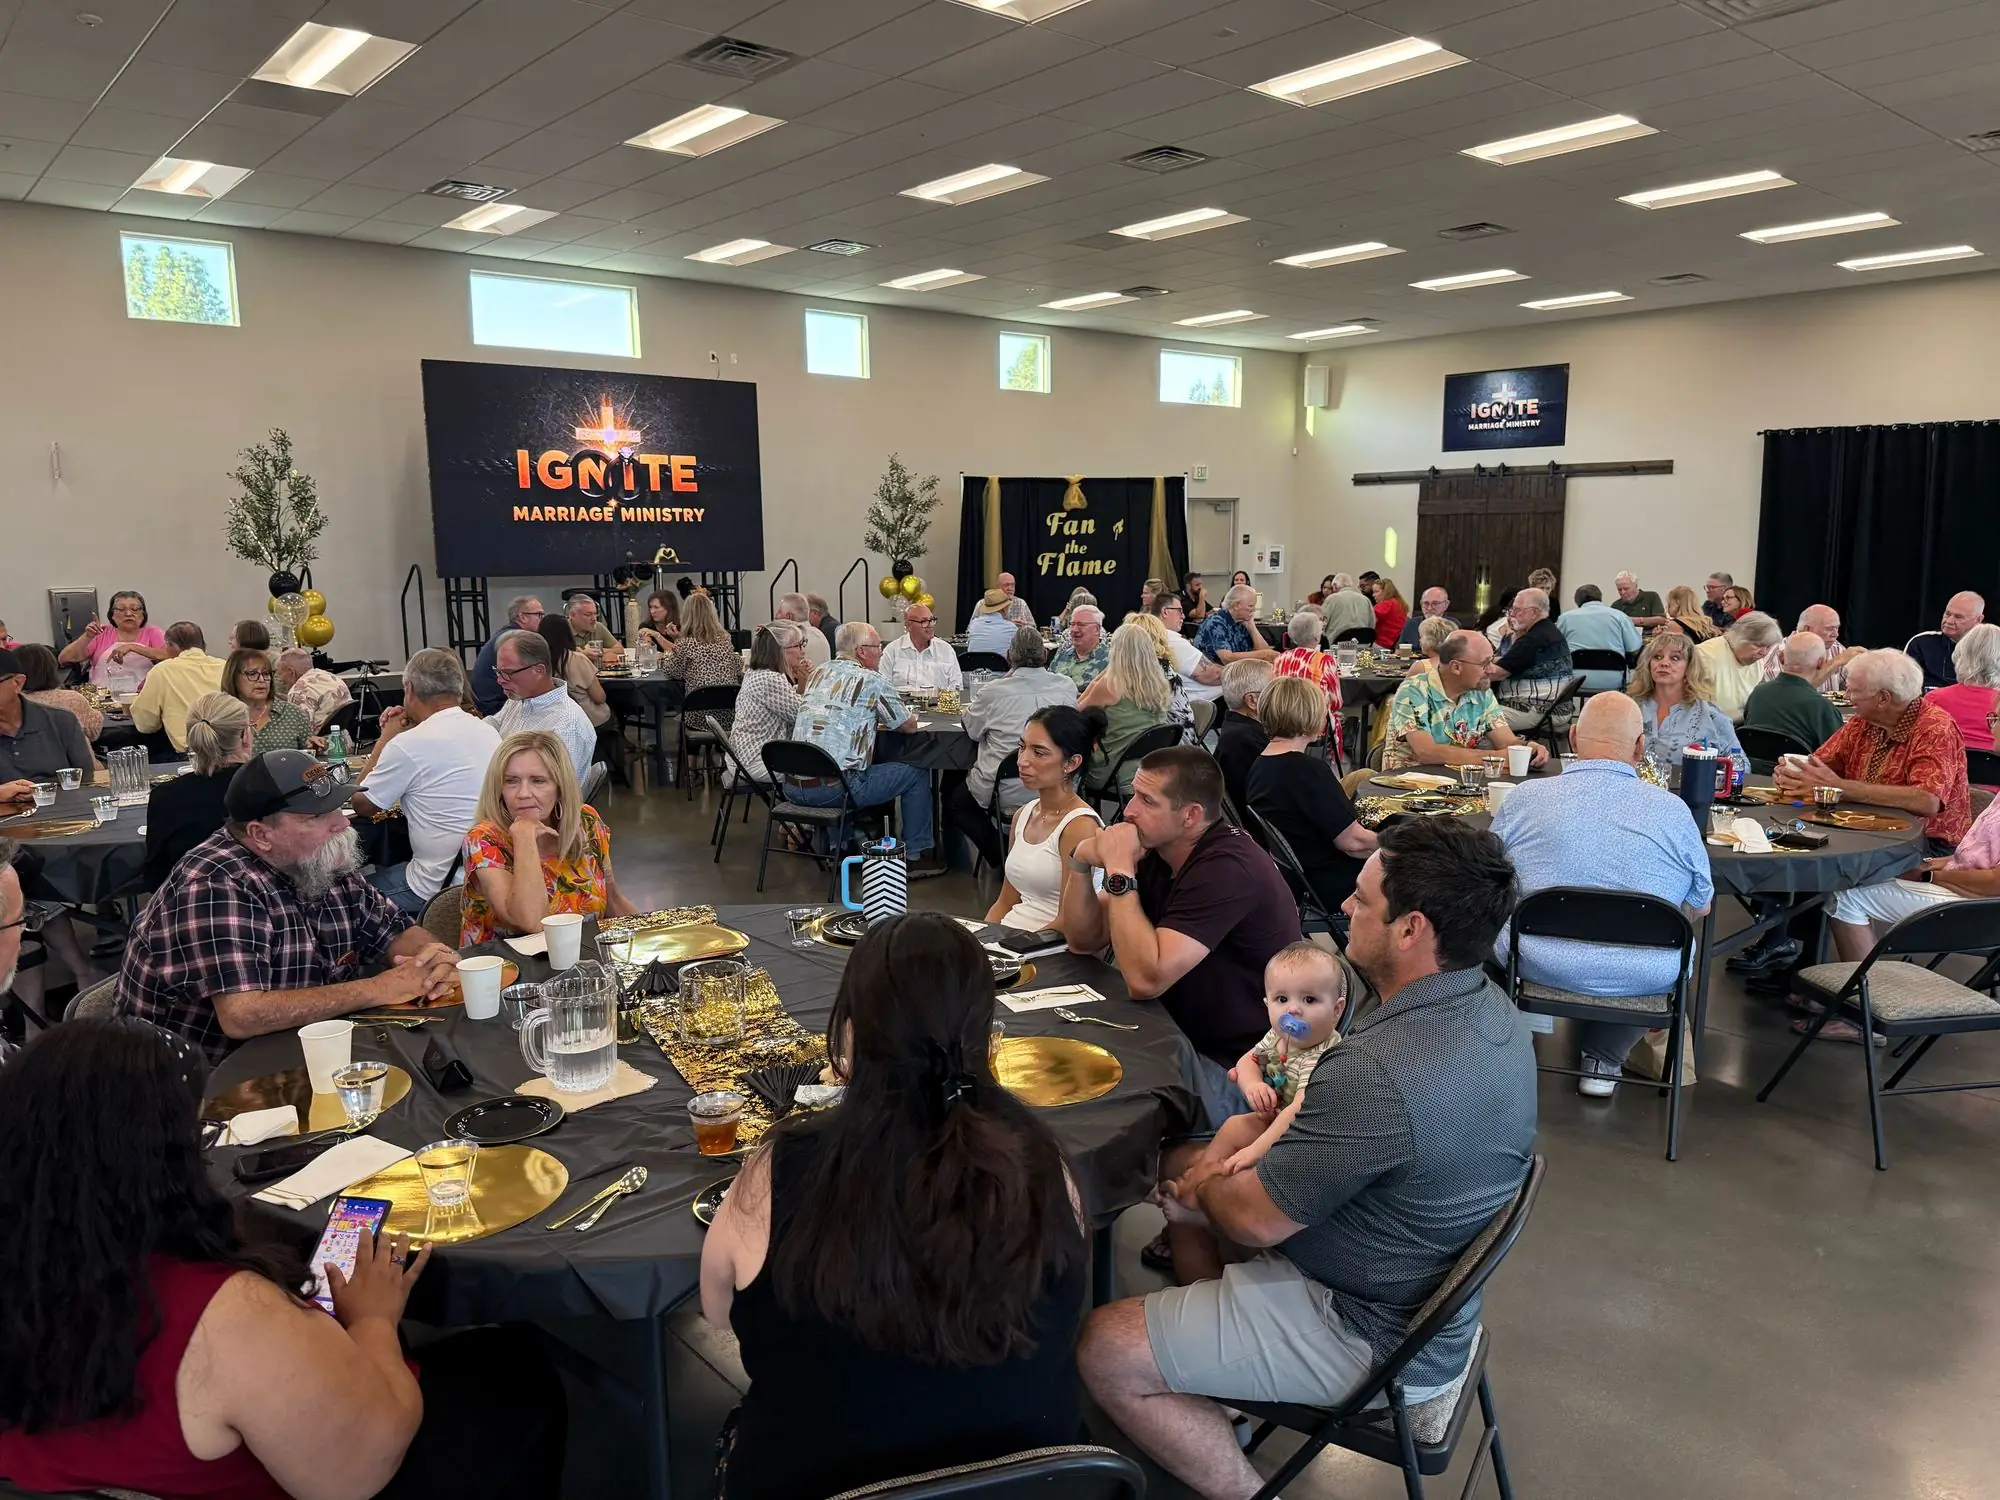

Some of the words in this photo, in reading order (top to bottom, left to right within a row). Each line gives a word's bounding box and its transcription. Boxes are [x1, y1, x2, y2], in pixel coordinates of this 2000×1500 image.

[1470, 398, 1539, 419] IGNITE
[1468, 421, 1504, 431] MARRIAGE
[1506, 419, 1541, 428] MINISTRY
[516, 449, 699, 492] IGNITE
[513, 506, 614, 522] MARRIAGE
[621, 507, 705, 522] MINISTRY
[1046, 512, 1097, 537] Fan
[1064, 540, 1088, 554] the
[1037, 552, 1117, 577] Flame
